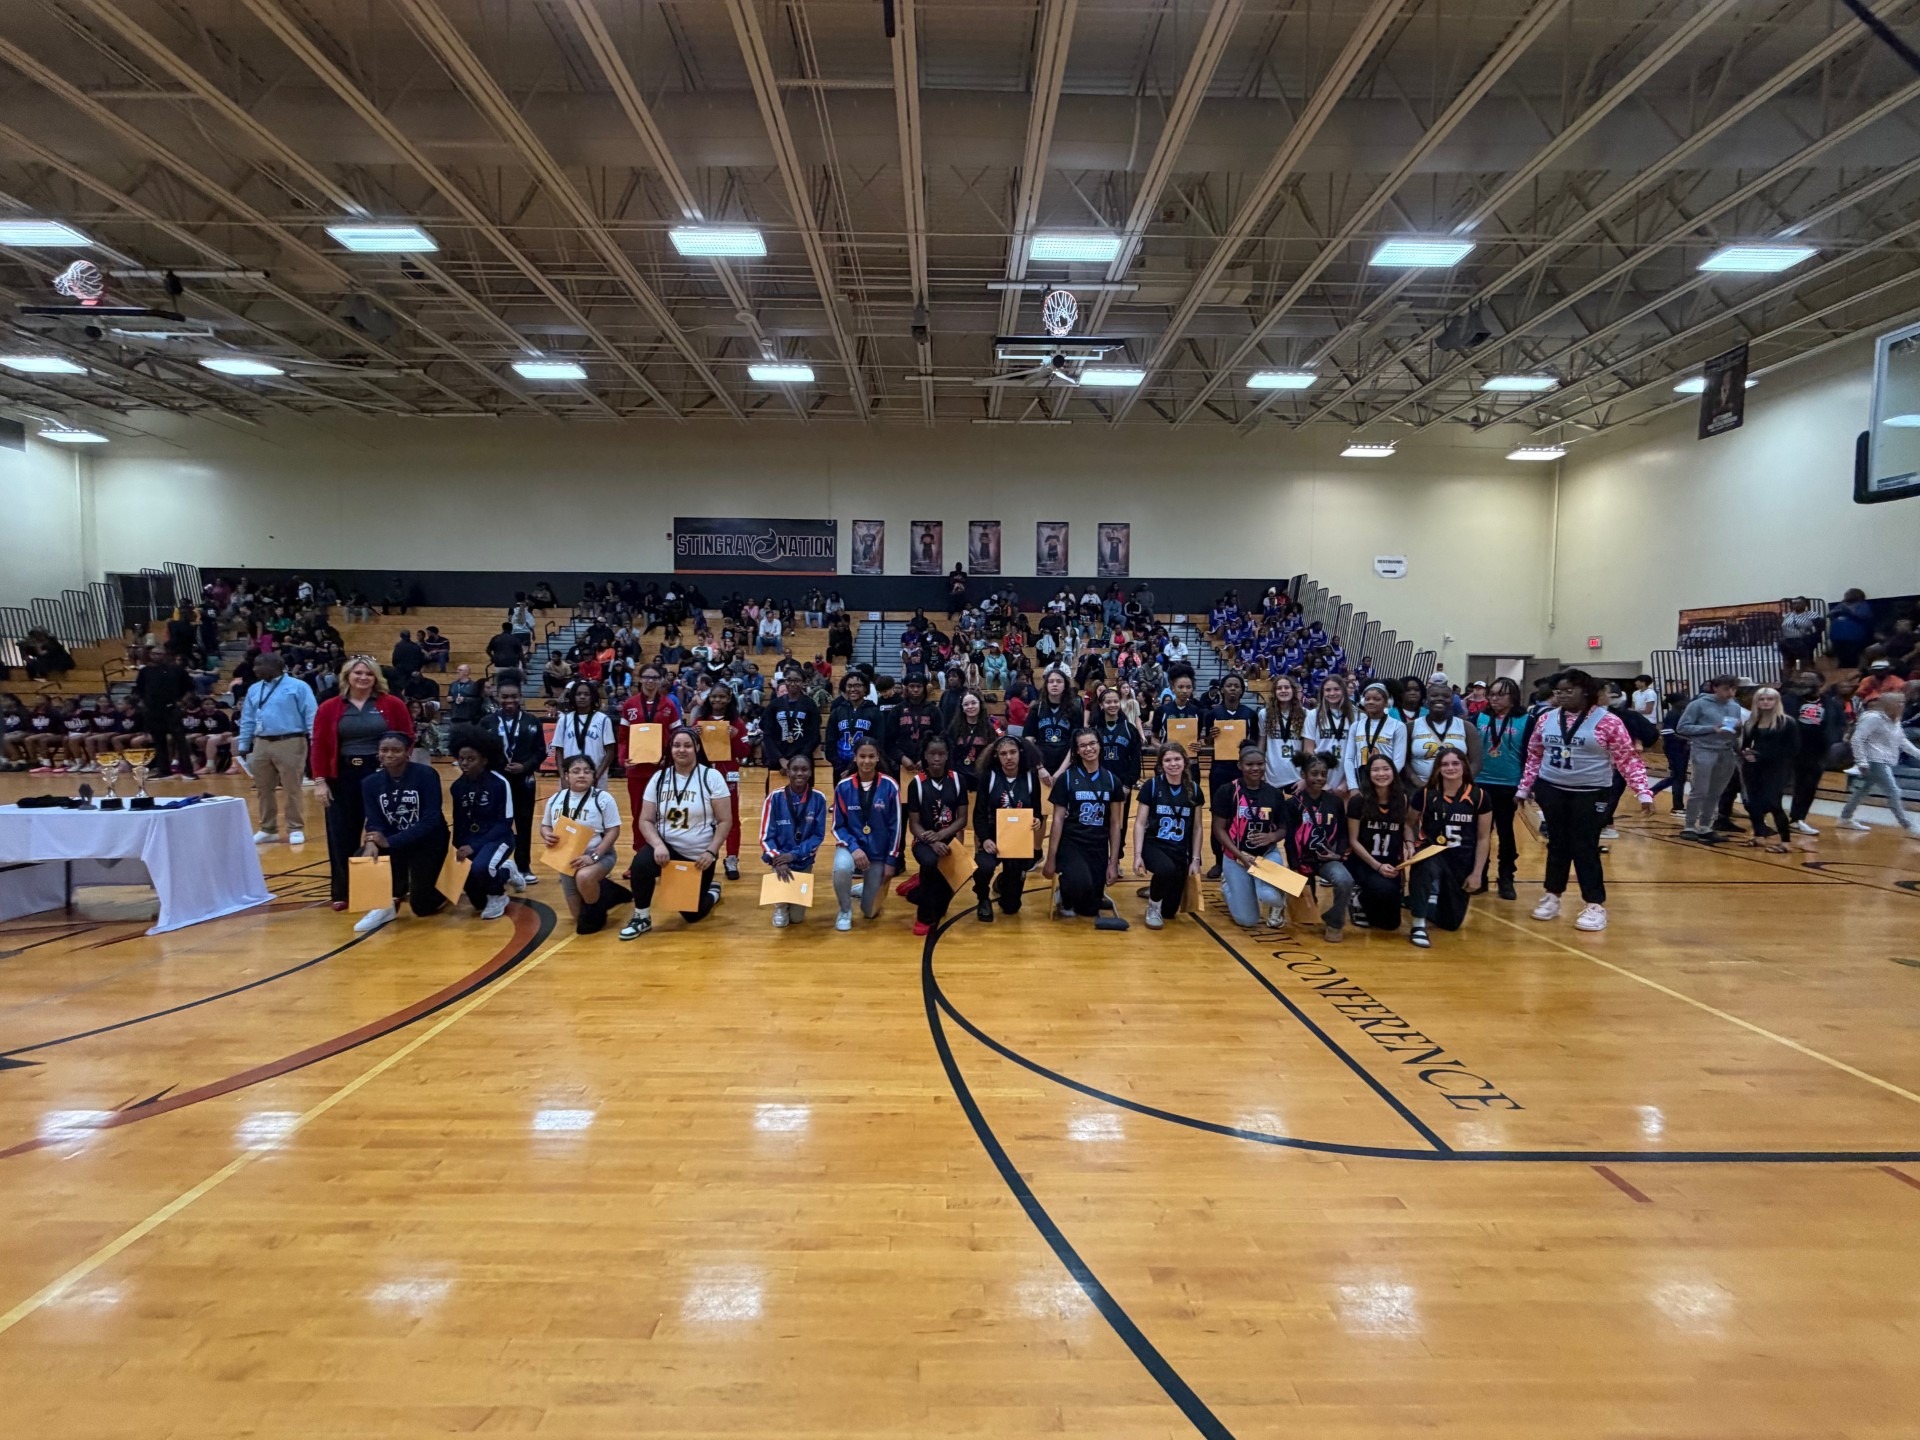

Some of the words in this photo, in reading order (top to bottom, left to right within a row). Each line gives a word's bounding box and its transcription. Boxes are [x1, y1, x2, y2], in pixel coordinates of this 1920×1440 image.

[677, 534, 756, 556] STINGRAY
[777, 535, 835, 557] NATION
[1545, 735, 1586, 746] WESTEW
[554, 808, 589, 820] DONT
[667, 807, 689, 829] 41
[1079, 802, 1106, 826] 22
[1434, 812, 1473, 822] LNDON
[1367, 820, 1400, 831] LAON
[1445, 825, 1462, 848] 5
[1371, 833, 1391, 856] 11
[1272, 950, 1525, 1111] CONFERENCE
